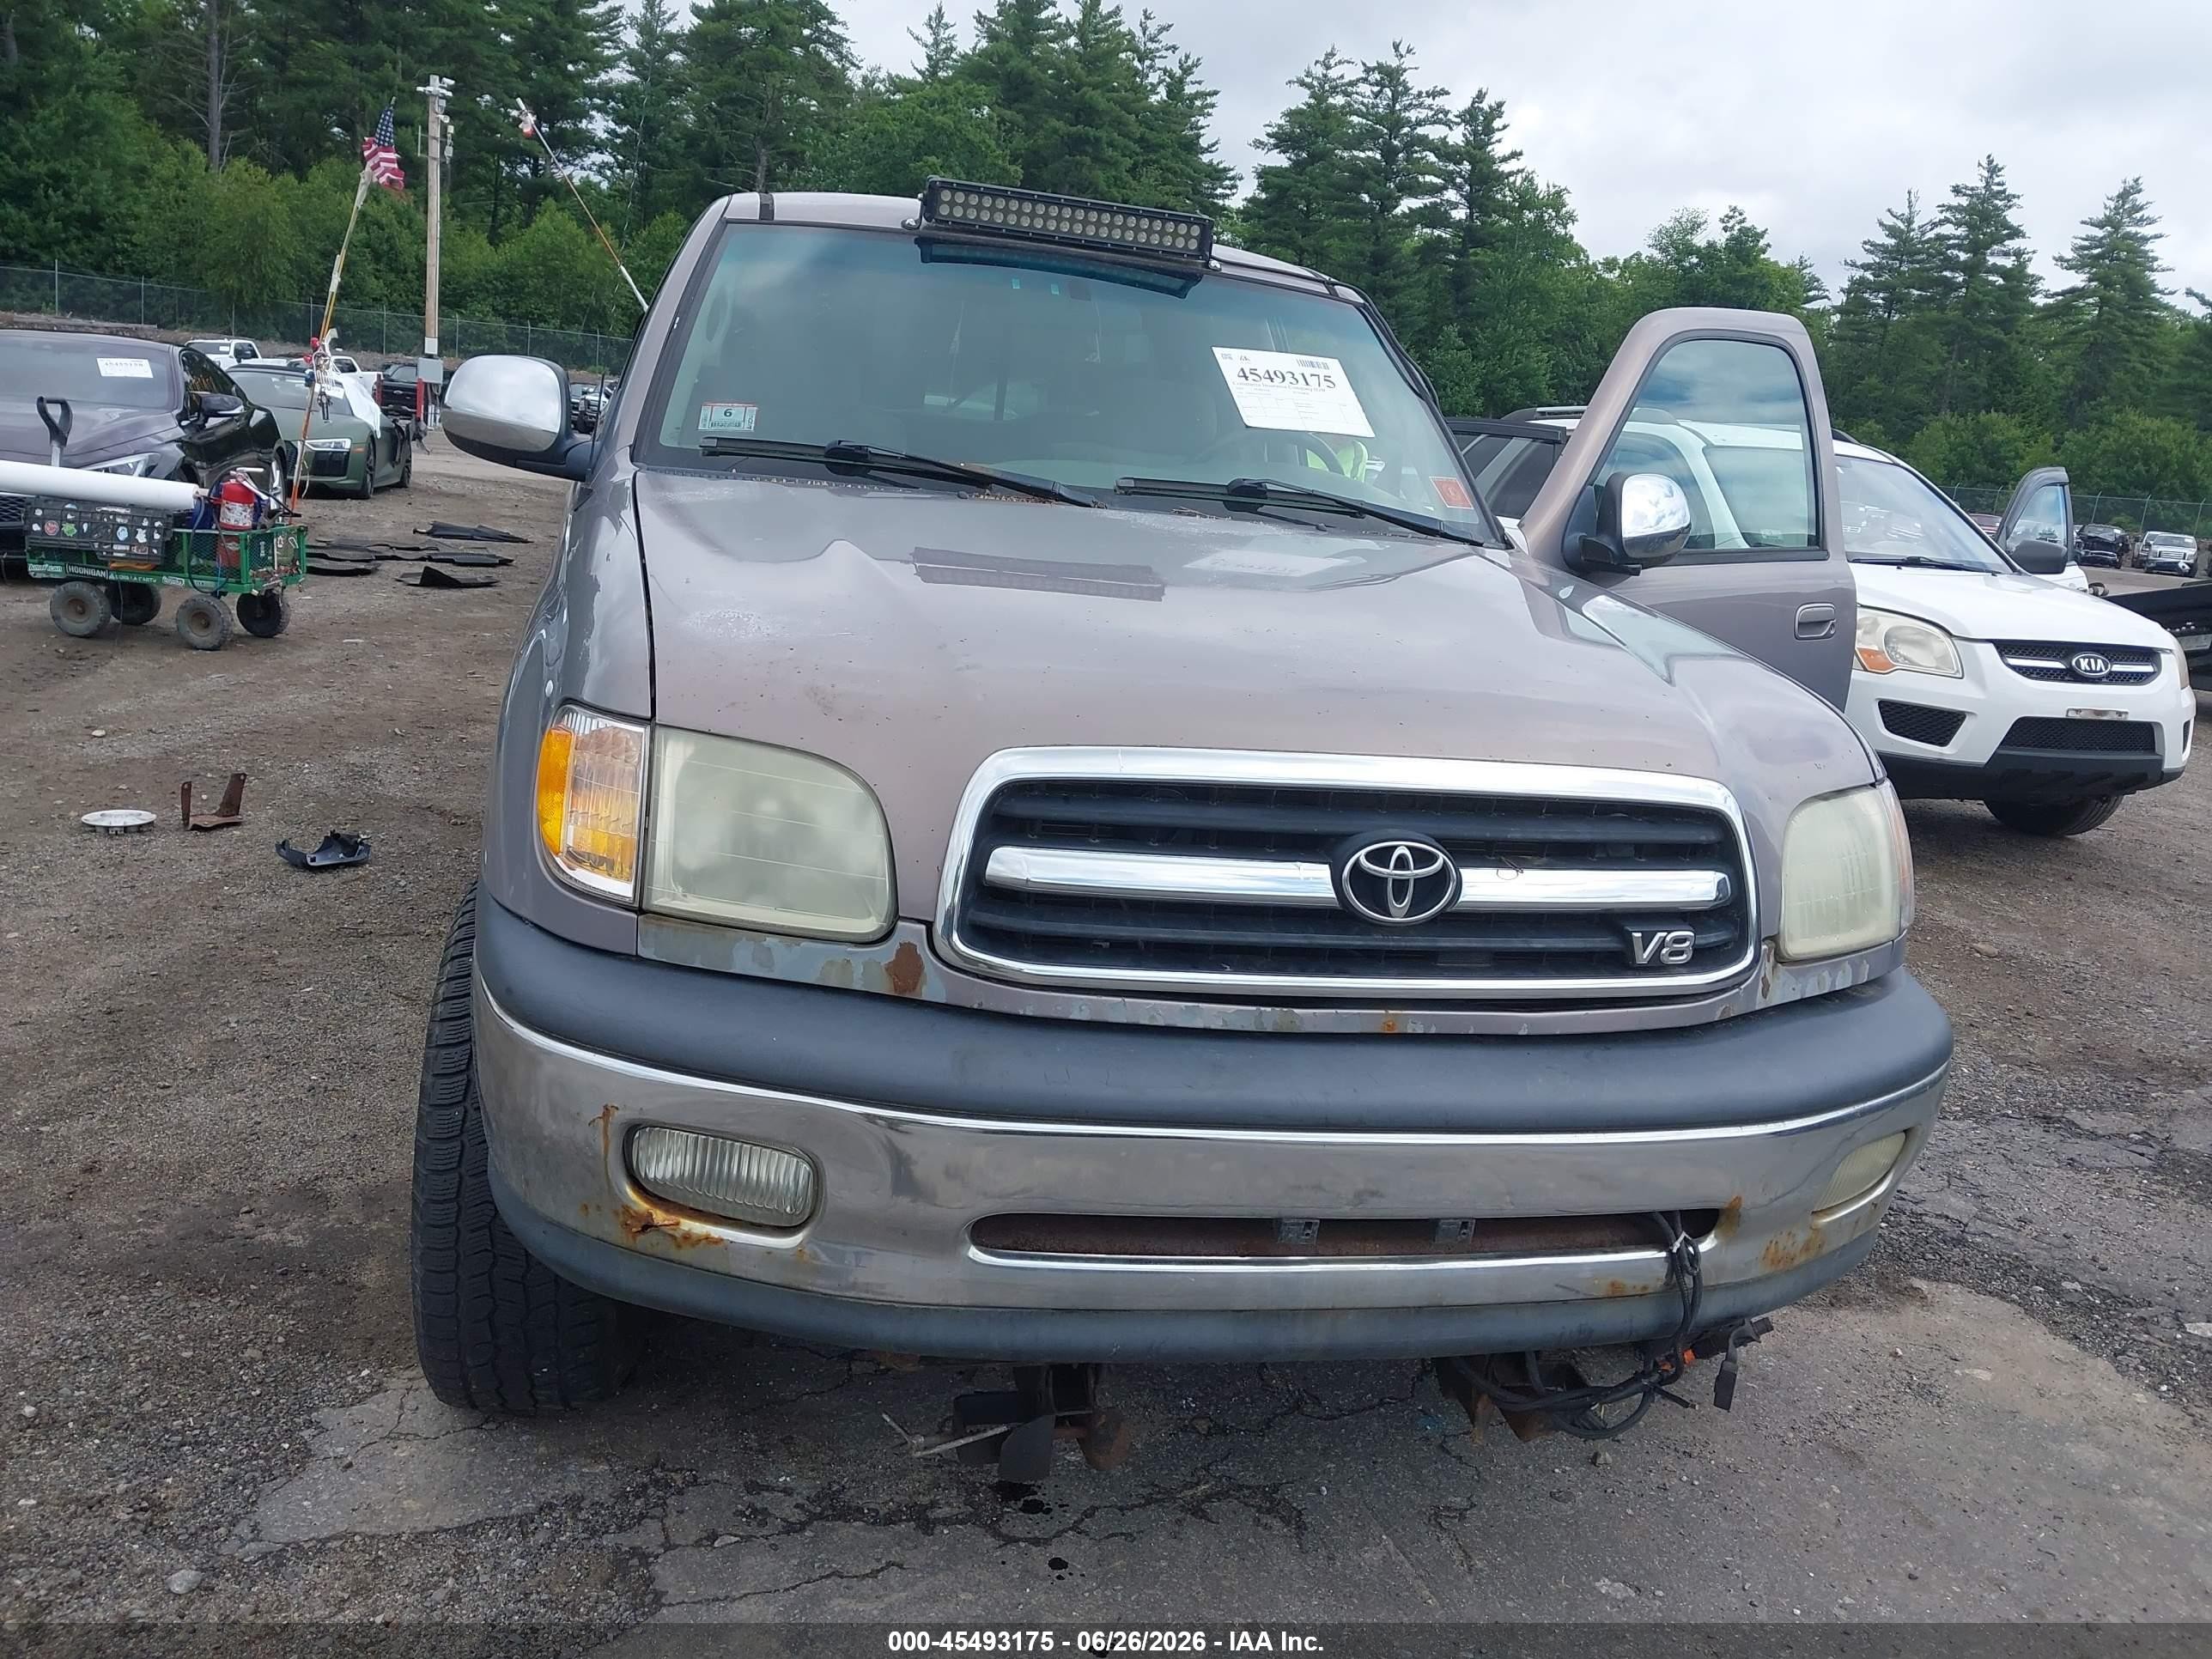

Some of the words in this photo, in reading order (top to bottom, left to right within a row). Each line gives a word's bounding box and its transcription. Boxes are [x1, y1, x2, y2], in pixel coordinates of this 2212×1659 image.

[1237, 367, 1336, 389] 45493175
[723, 408, 732, 417] 6
[2079, 658, 2106, 672] KIA
[1632, 931, 1695, 964] V8
